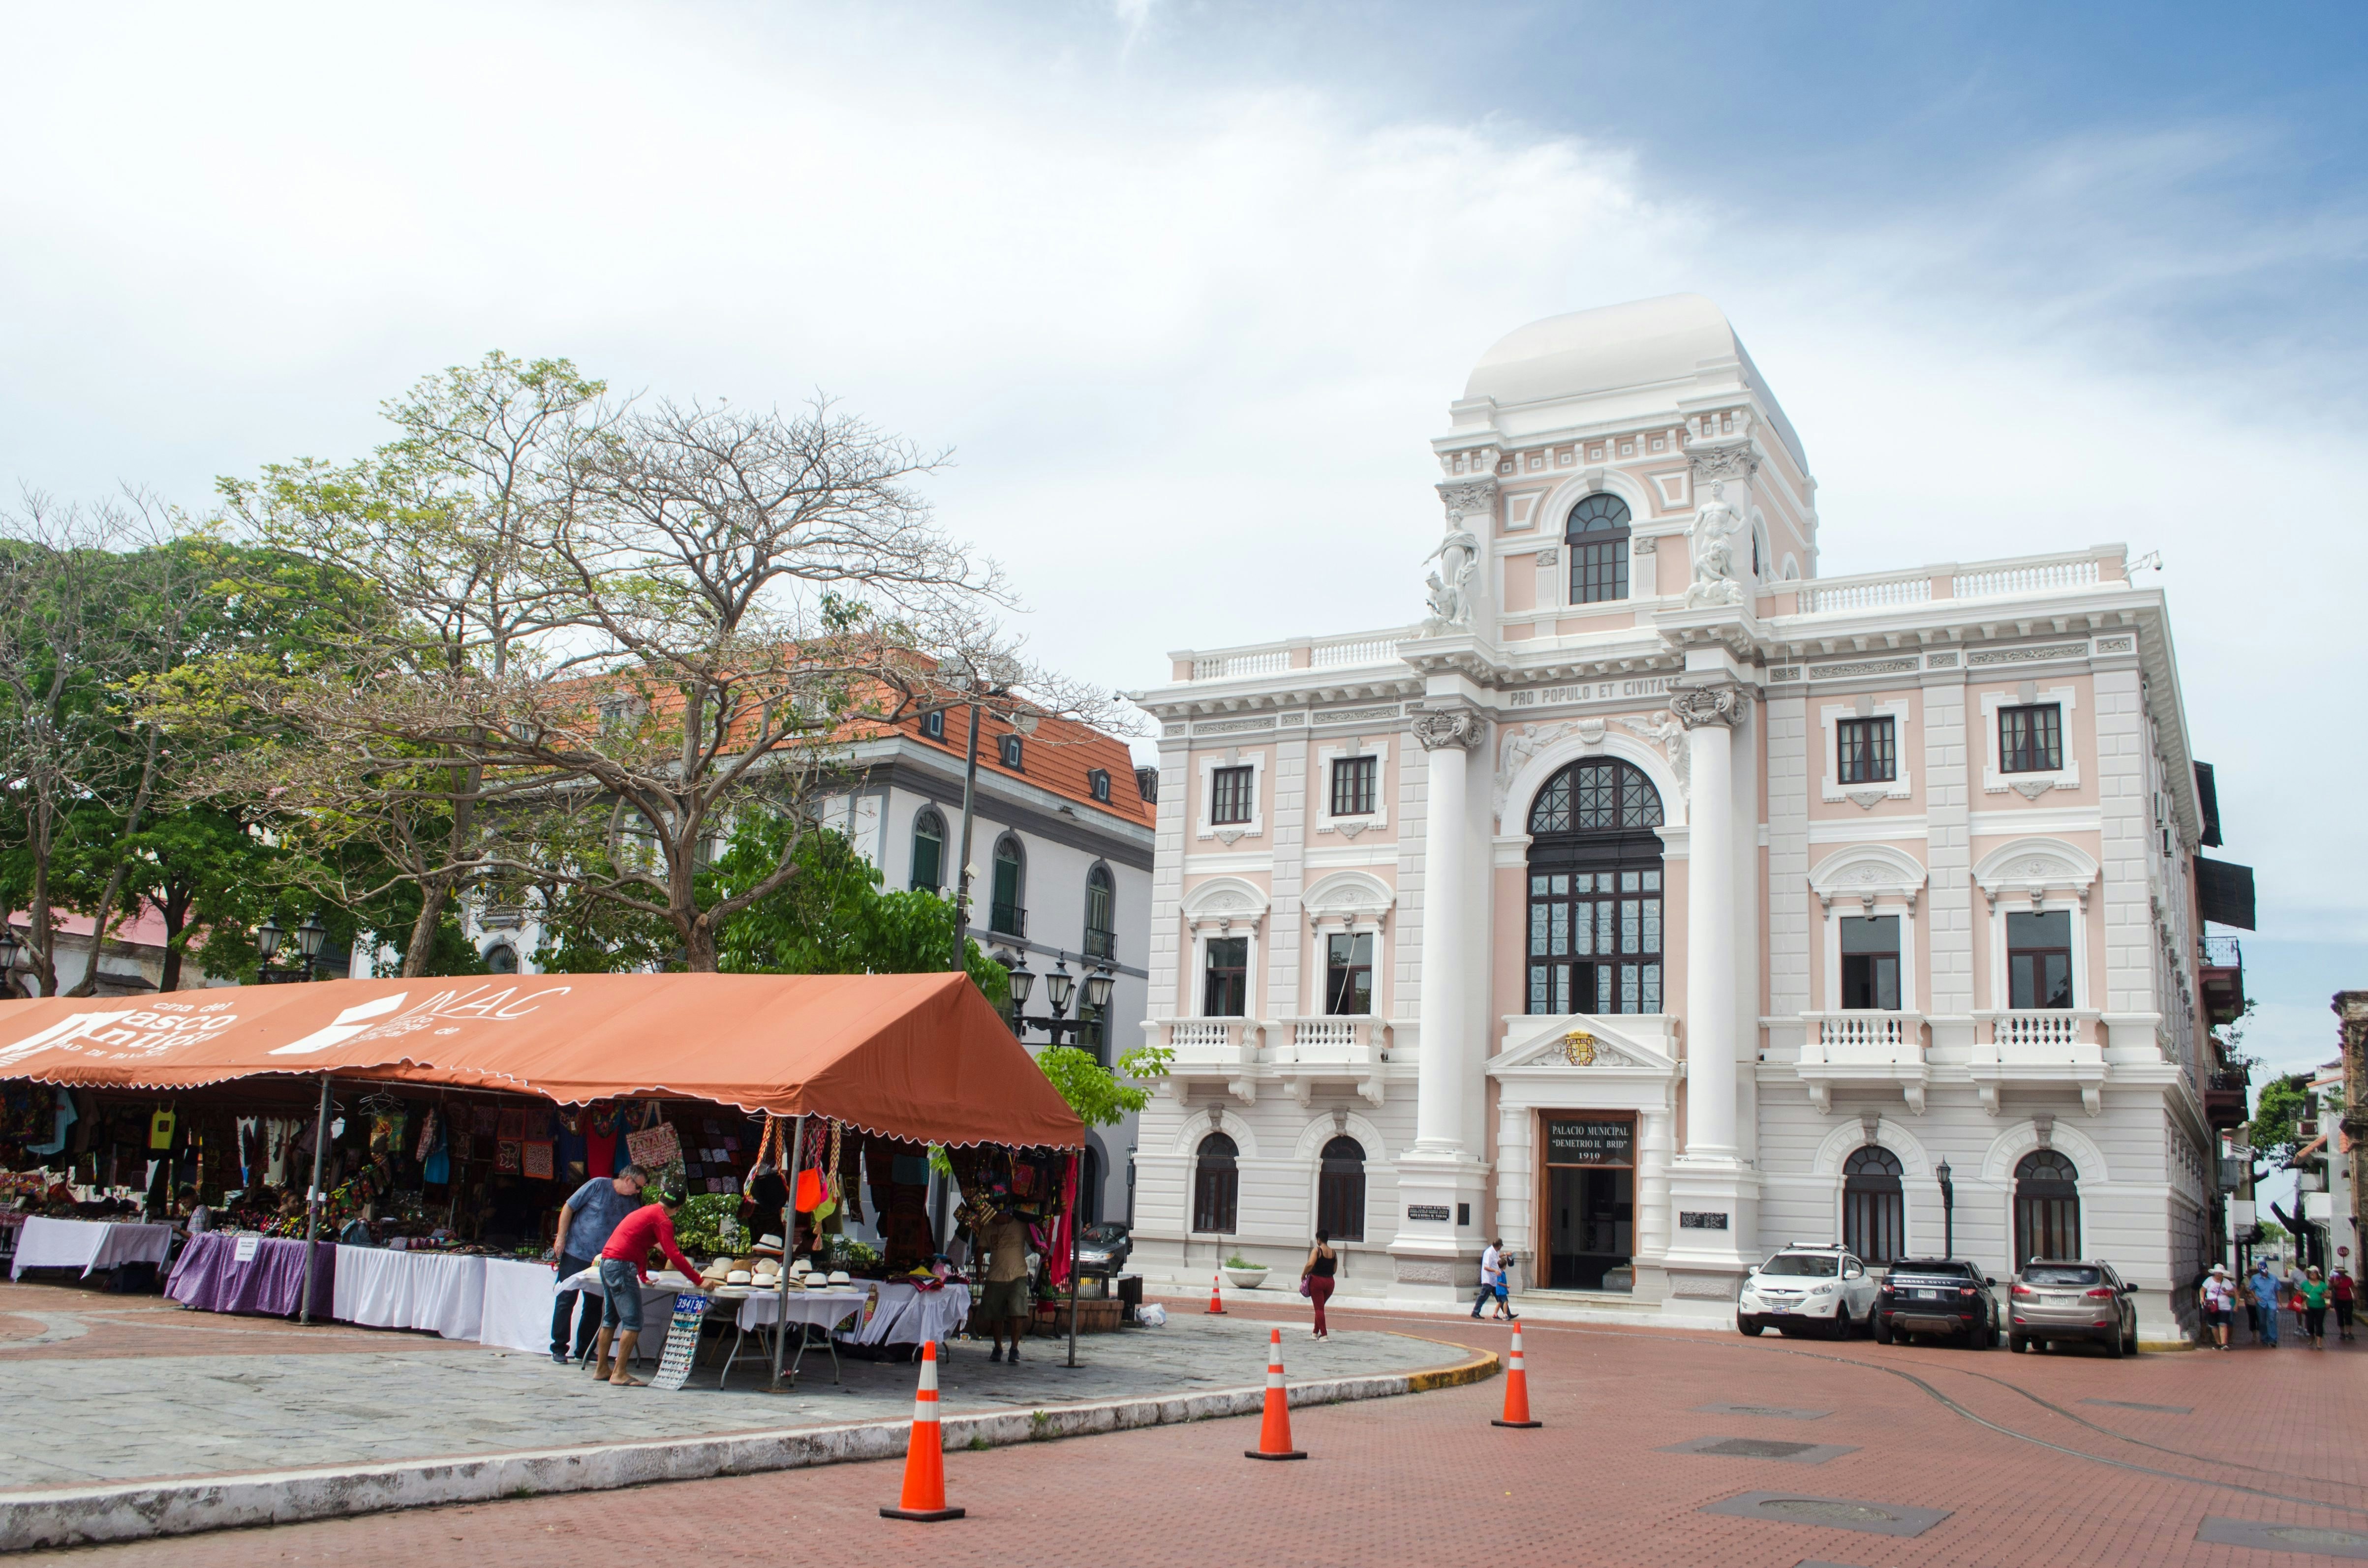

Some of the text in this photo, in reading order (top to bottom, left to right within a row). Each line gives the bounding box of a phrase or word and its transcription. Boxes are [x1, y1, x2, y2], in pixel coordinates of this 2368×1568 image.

[1510, 691, 1534, 706] PRO
[1542, 686, 1590, 703] POPULO
[1599, 684, 1614, 697] ET
[199, 1001, 234, 1012] del
[1552, 1126, 1629, 1136] PALACIO MUNICIPAL
[677, 1298, 704, 1310] 394136
